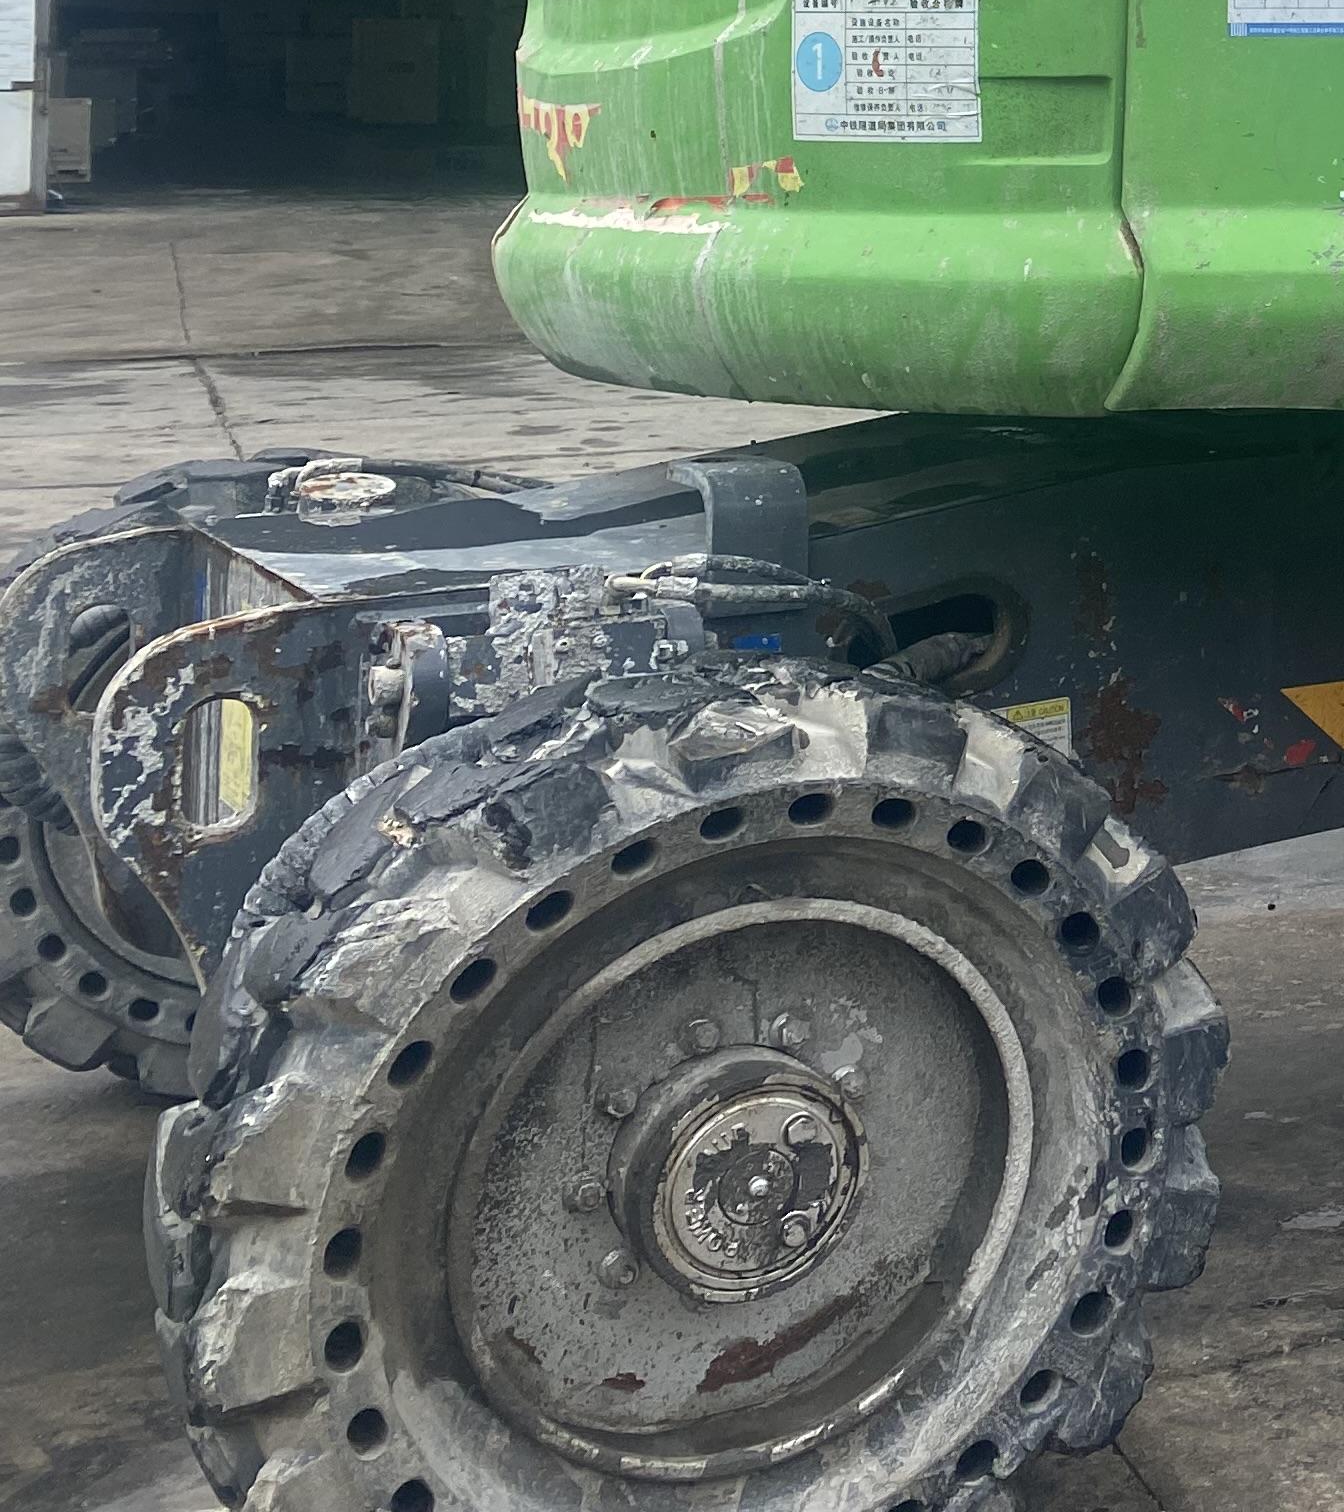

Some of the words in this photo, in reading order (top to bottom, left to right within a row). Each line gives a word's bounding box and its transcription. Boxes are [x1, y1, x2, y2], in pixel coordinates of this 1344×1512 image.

[811, 43, 823, 80] 1
[851, 51, 900, 62] 验收责人
[840, 120, 948, 133] 中铁隧道局集团有限公司
